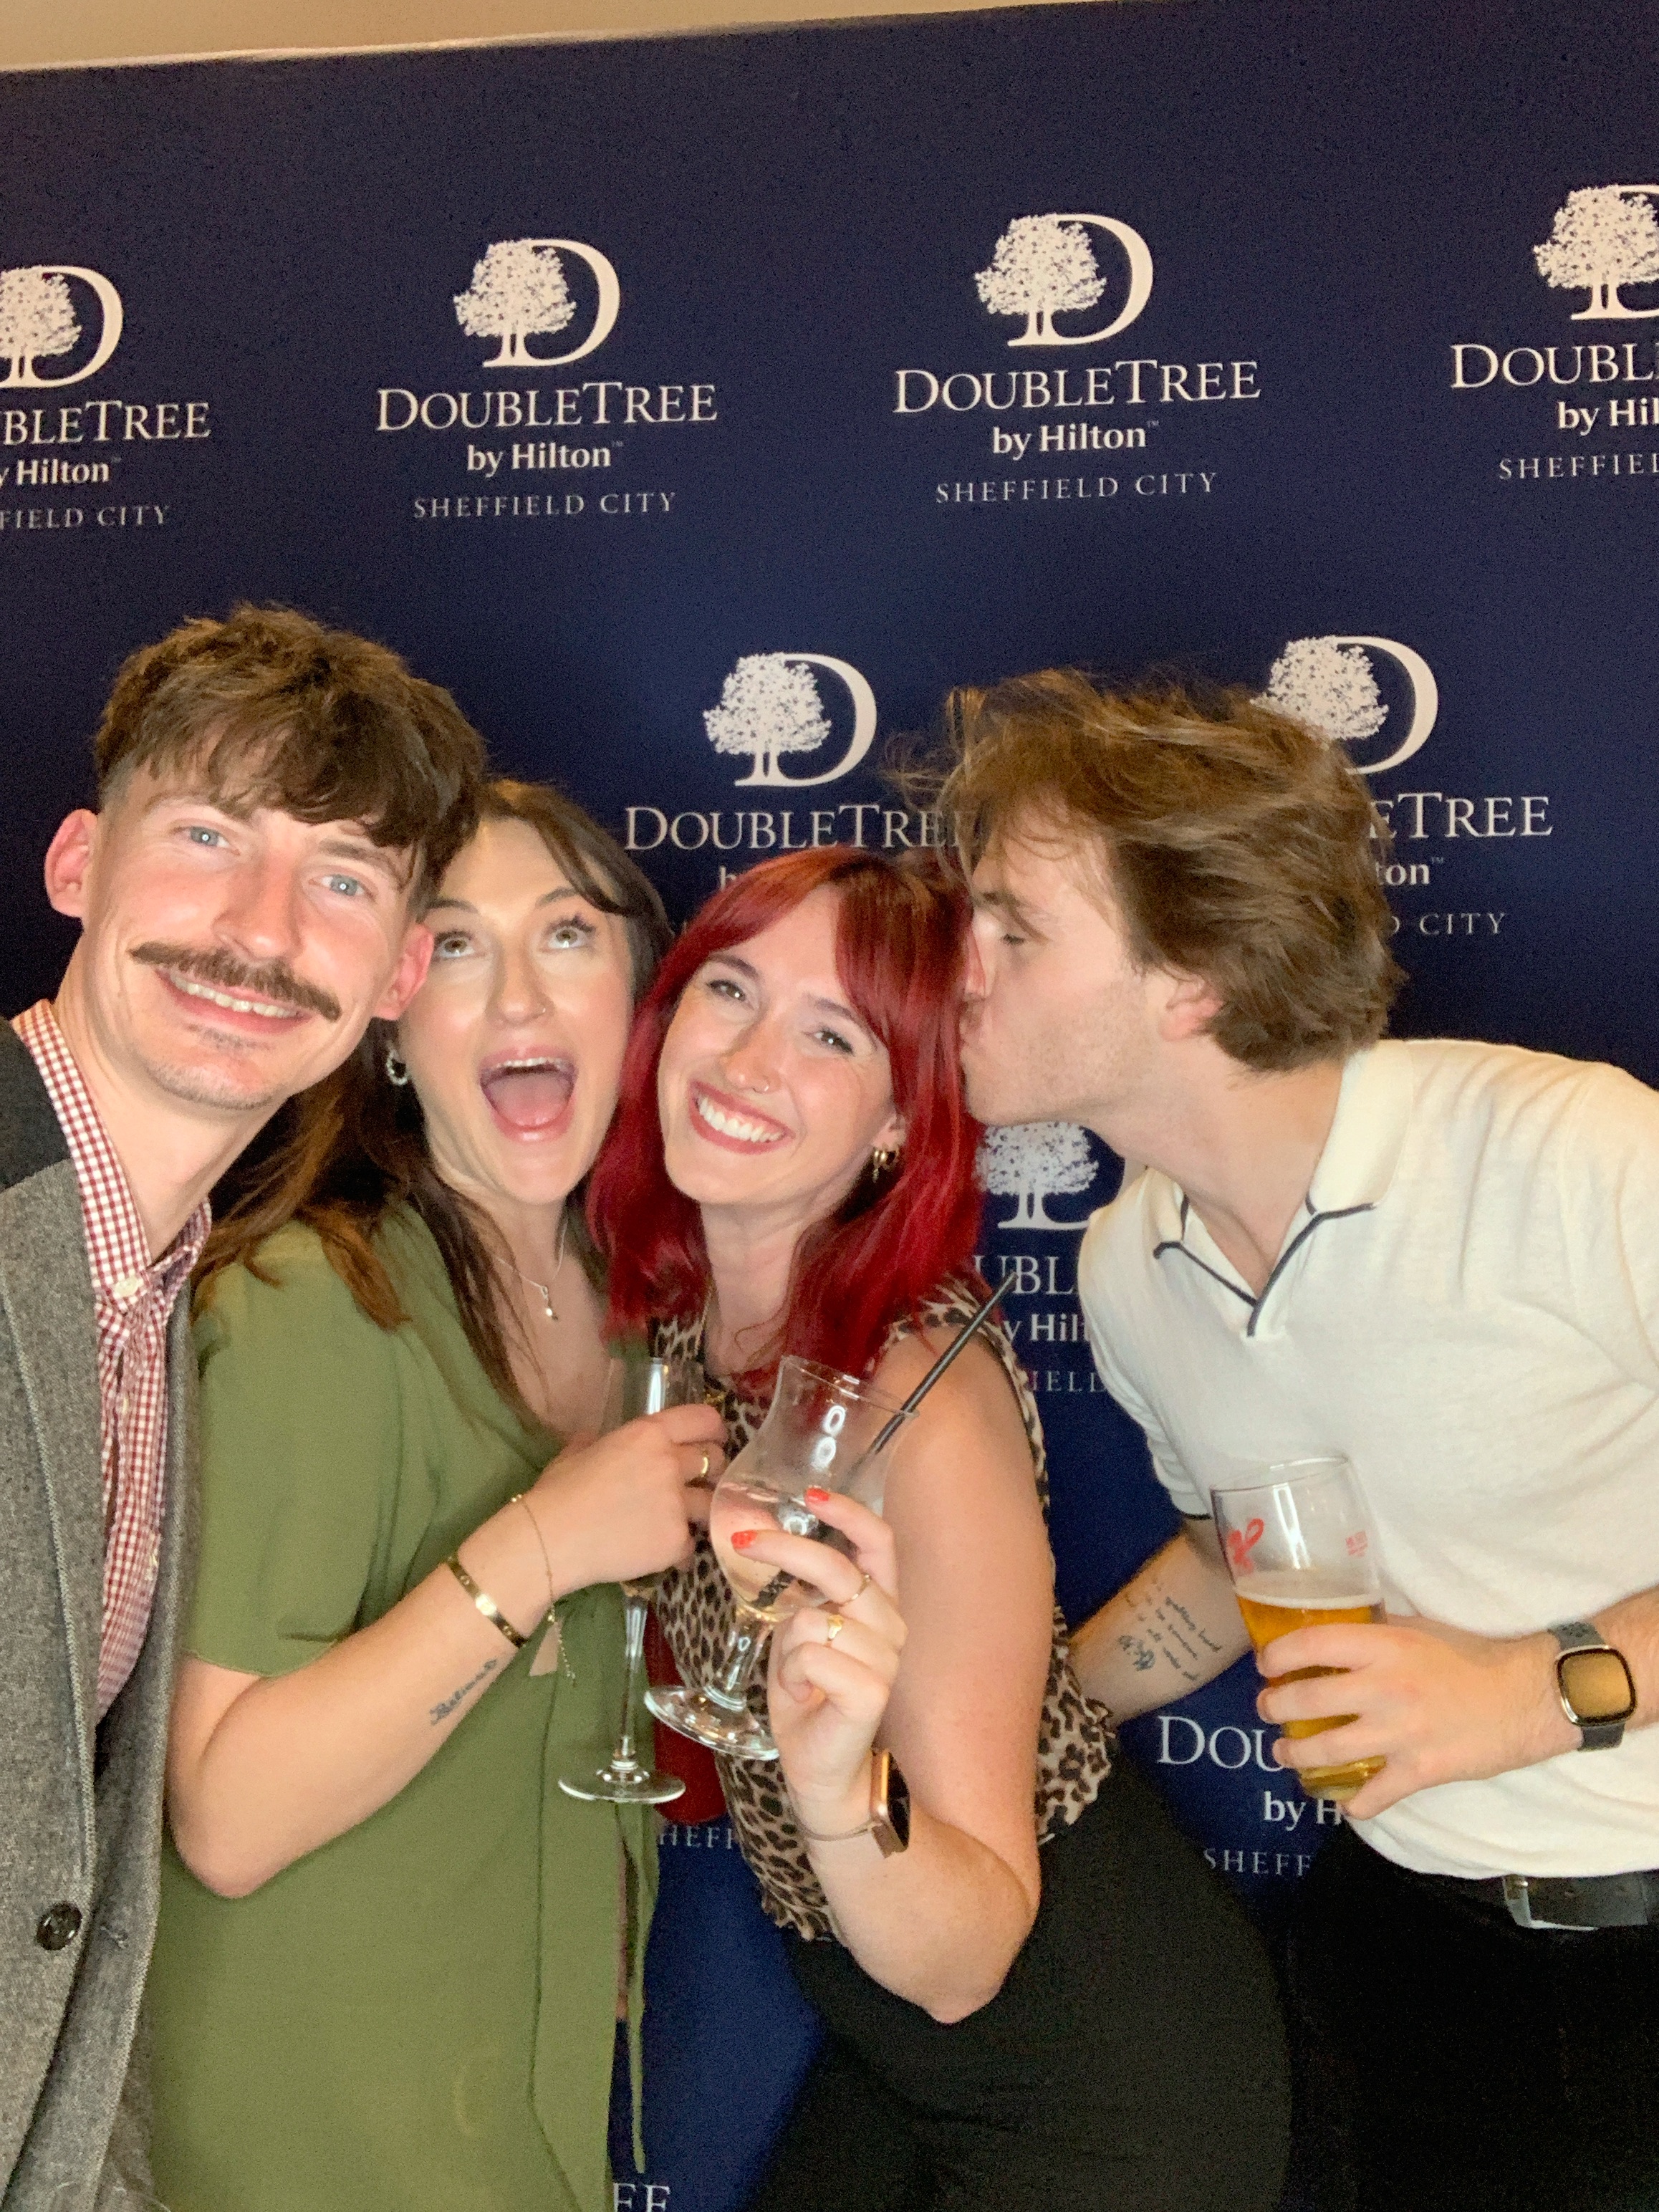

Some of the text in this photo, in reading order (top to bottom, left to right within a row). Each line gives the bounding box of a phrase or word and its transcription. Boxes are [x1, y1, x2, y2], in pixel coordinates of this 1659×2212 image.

[1450, 342, 1659, 389] DOUBL
[893, 360, 1261, 413] DOUBLETREE
[0, 400, 211, 446] BLETREE
[377, 381, 718, 431] DOUBLETREE
[1557, 401, 1600, 436] by
[993, 426, 1032, 461] by
[467, 444, 504, 479] by
[413, 491, 677, 519] SHEFFIELD CITY
[936, 471, 1218, 504] SHEFFIELD CITY
[97, 504, 169, 527] CITY
[1419, 912, 1506, 936] CITY
[1264, 1789, 1307, 1832] by
